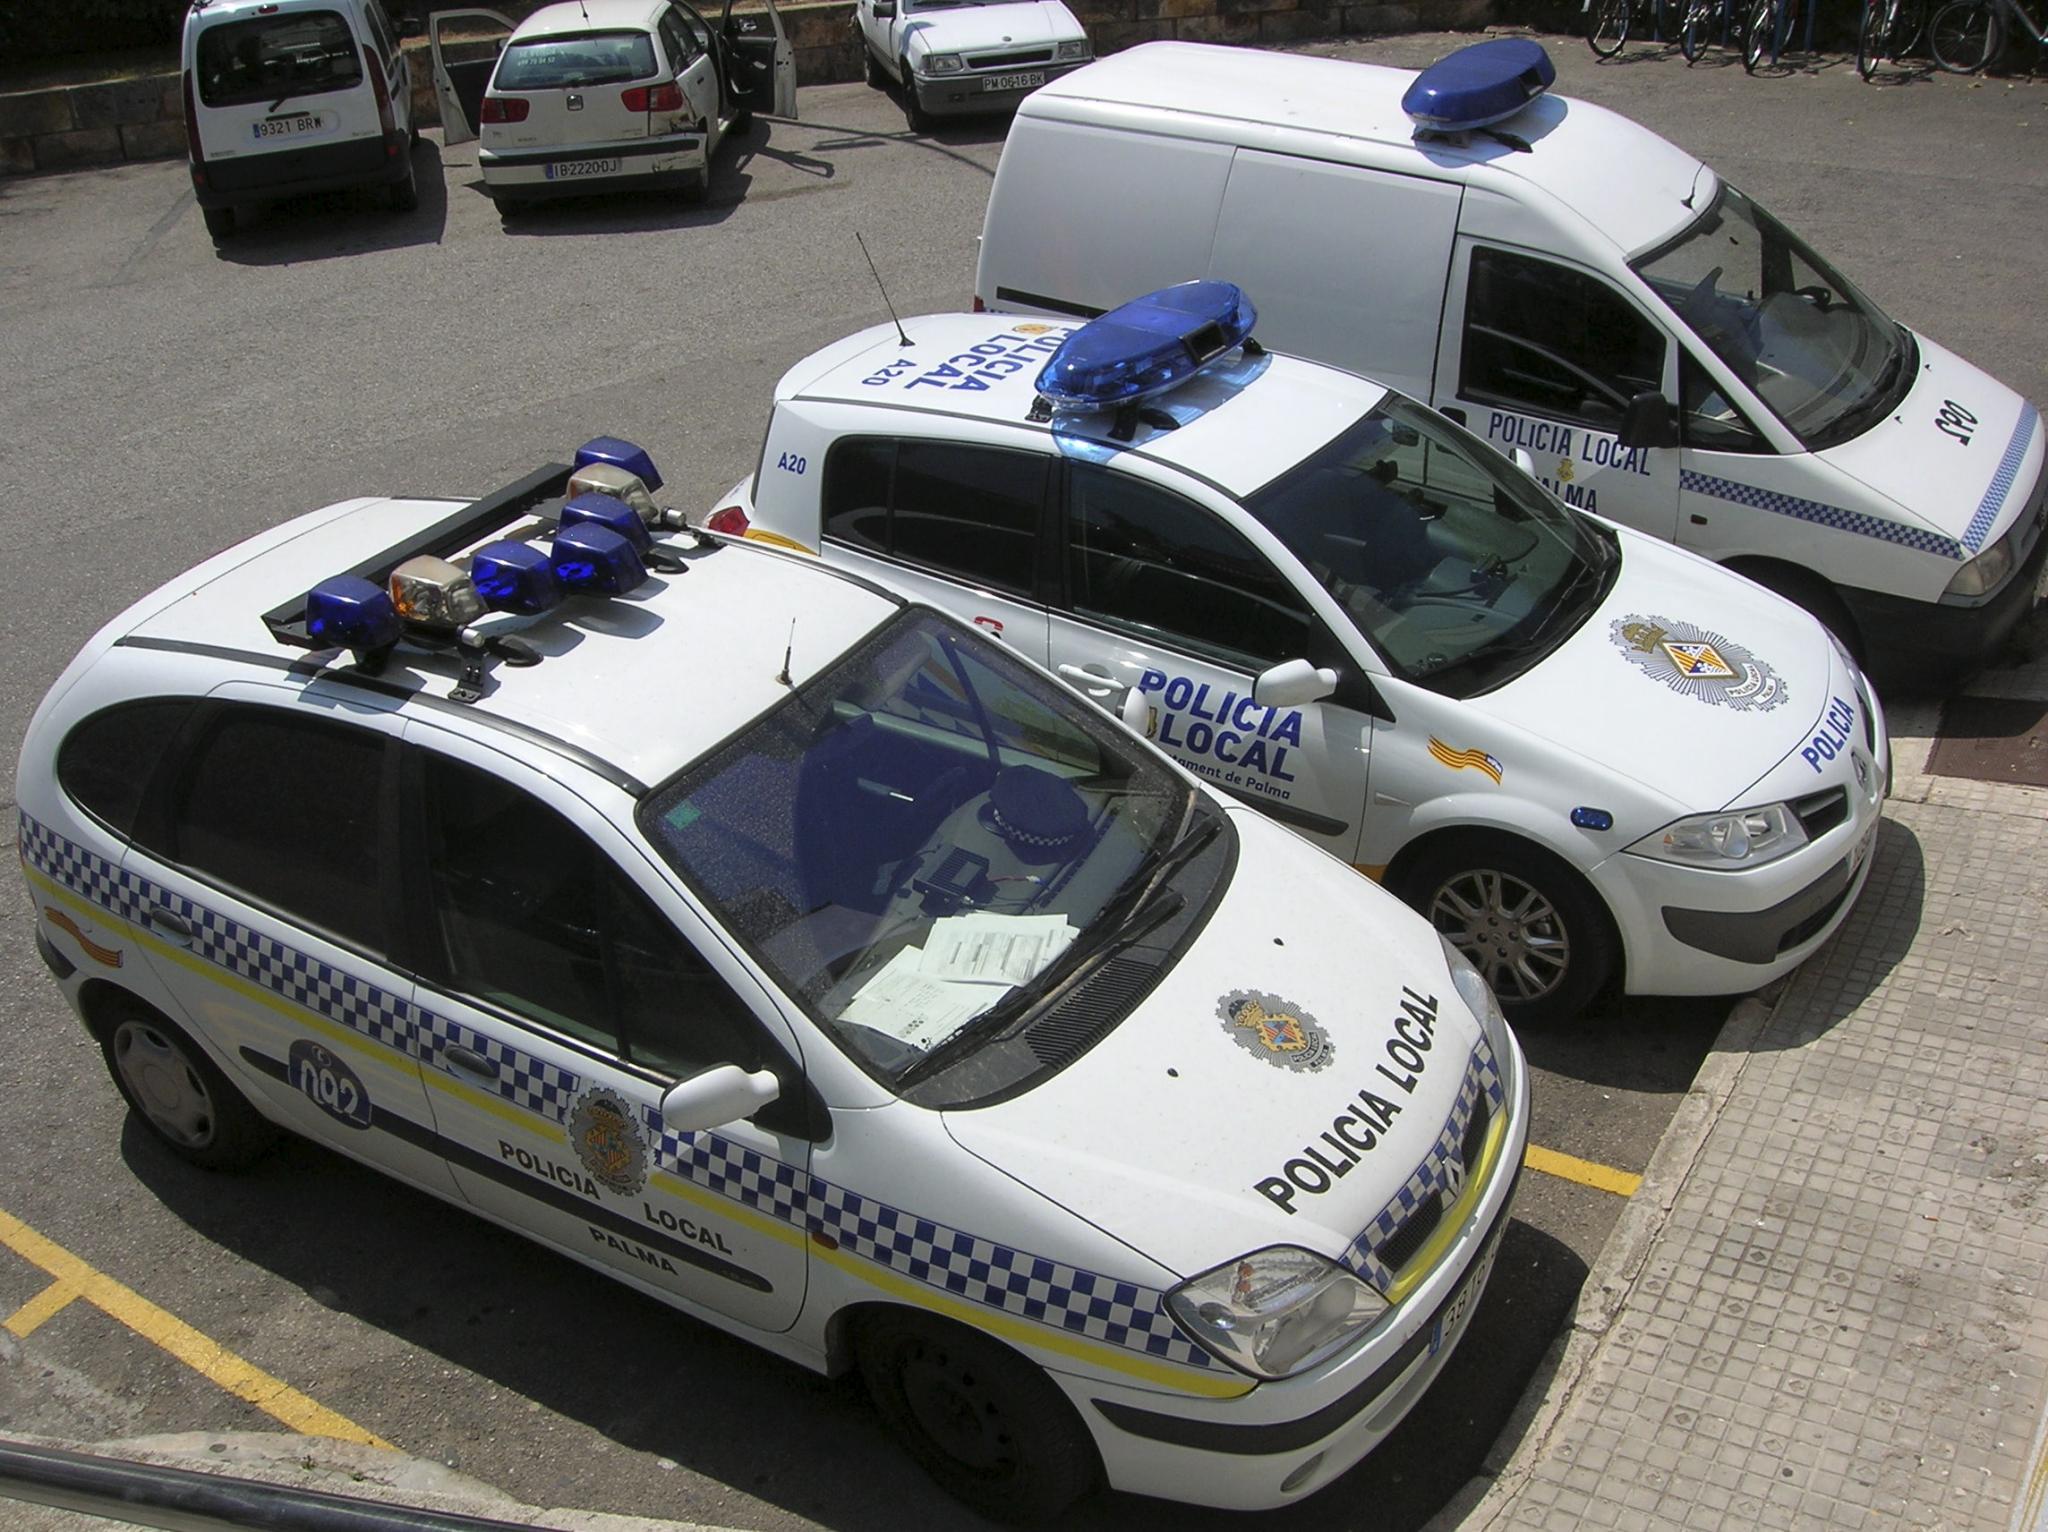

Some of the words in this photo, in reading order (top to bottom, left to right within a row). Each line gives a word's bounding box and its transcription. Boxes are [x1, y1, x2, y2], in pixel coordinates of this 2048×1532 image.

[260, 121, 291, 137] 9321
[861, 358, 917, 386] A20
[904, 334, 1028, 390] LOCAL
[777, 451, 807, 475] A20
[1488, 412, 1572, 457] POLICIA
[1581, 433, 1651, 476] LOCAL
[1138, 667, 1304, 748] POLICIA
[1801, 696, 1855, 774] POLICIA
[1158, 713, 1296, 782] LOCAL
[1224, 771, 1241, 785] de
[1246, 776, 1290, 800] Palma
[1253, 1089, 1403, 1215] POLICIA
[1375, 985, 1438, 1094] LOCAL
[498, 1139, 600, 1199] POLICIA
[588, 1226, 678, 1276] PALMA
[643, 1202, 733, 1255] LOCAL
